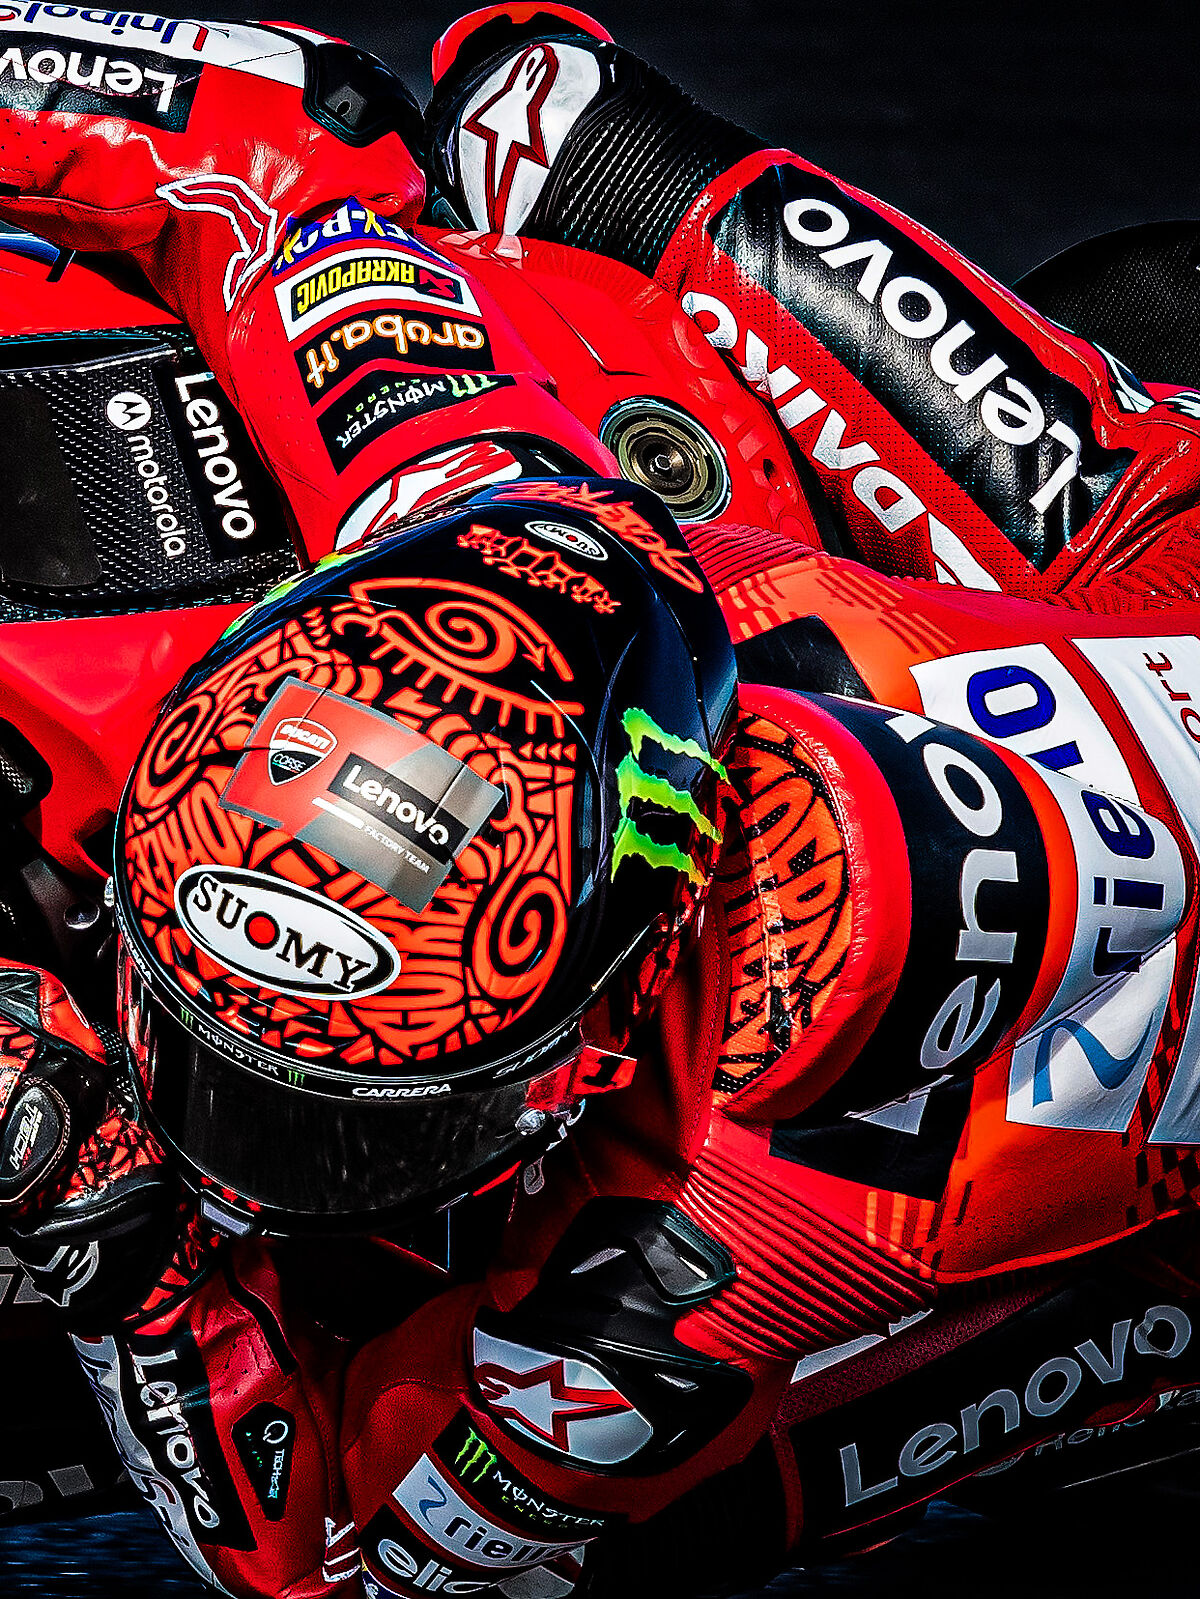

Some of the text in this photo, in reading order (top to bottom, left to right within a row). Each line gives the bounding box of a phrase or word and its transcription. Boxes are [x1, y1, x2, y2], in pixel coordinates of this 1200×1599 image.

[307, 314, 485, 388] aruba.it
[783, 198, 1083, 516] Lenovo
[335, 380, 447, 448] MONSTER
[174, 371, 256, 541] Lenovo
[127, 435, 186, 558] motorola
[537, 522, 601, 557] SUOMY
[280, 724, 331, 751] DUCATI
[342, 764, 450, 846] Lenovo
[404, 848, 431, 875] TEAM
[192, 872, 374, 993] SUOMY
[198, 1024, 279, 1076] MONSTER
[352, 1083, 452, 1098] CARRERA
[132, 1349, 220, 1529] Lenovo
[839, 1304, 1192, 1507] Lenovo
[492, 1470, 605, 1527] MONSTER
